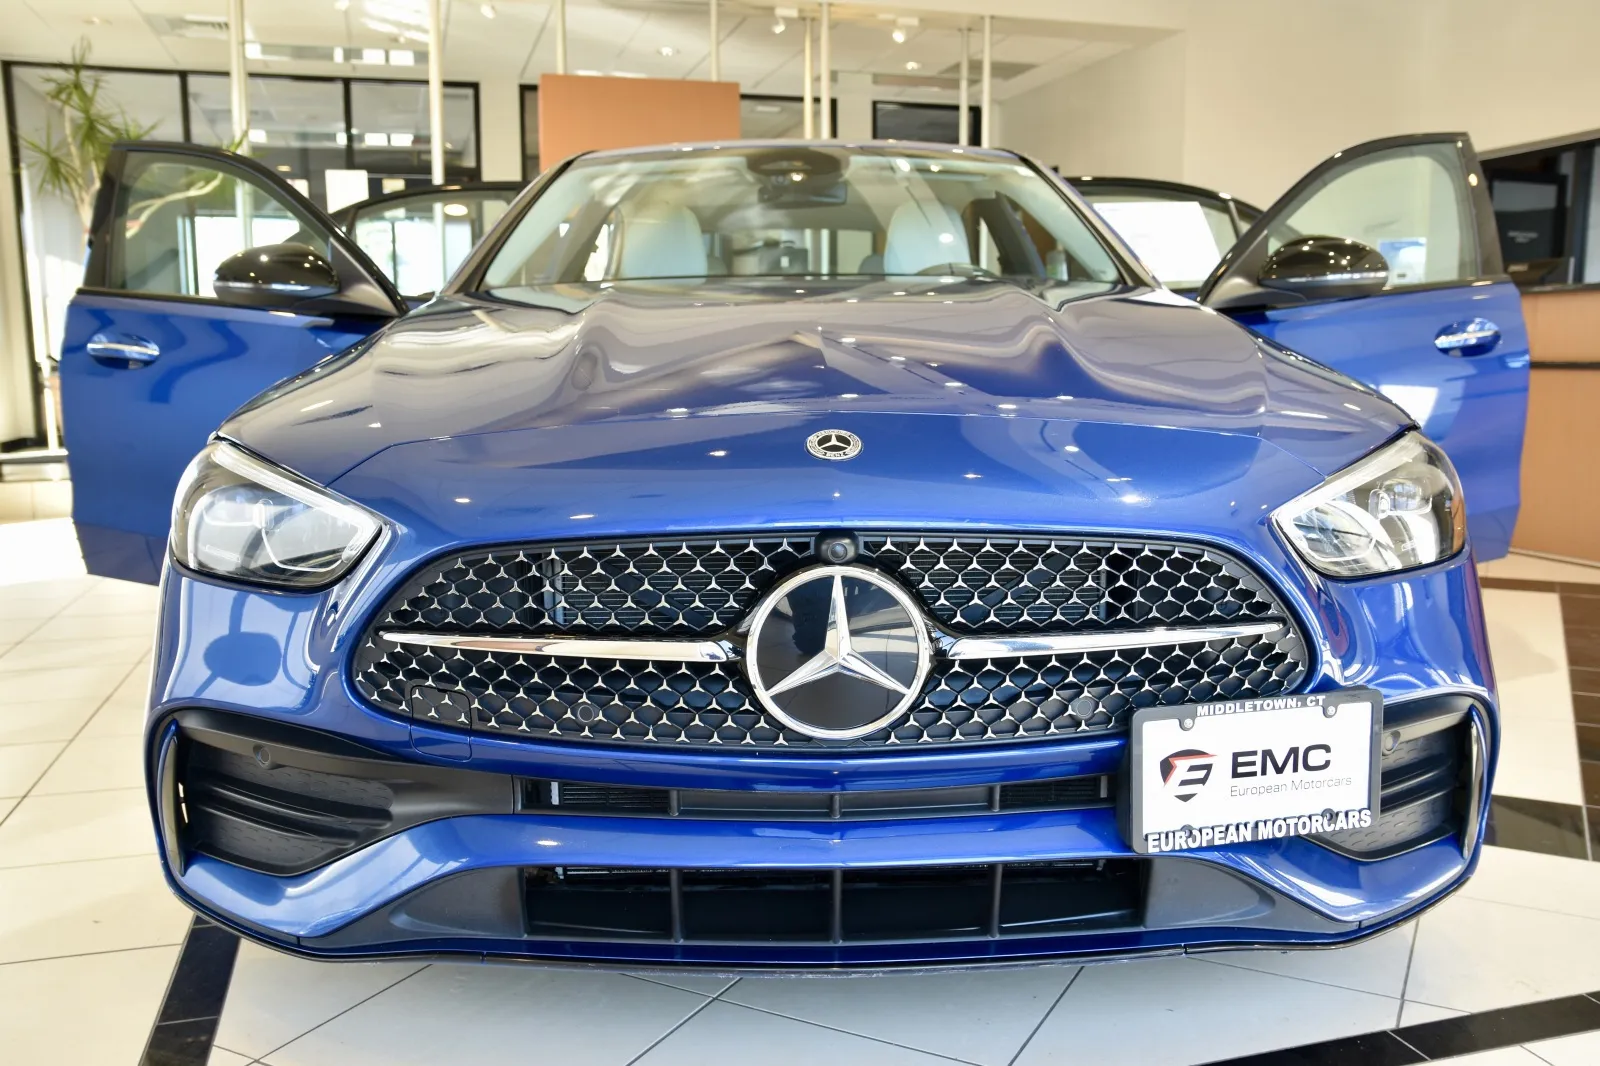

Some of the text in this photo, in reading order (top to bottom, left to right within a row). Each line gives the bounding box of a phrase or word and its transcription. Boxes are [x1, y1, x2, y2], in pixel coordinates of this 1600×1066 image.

[1196, 695, 1326, 717] MIDDLETOWN, CT
[1231, 743, 1332, 779] EMC
[1230, 777, 1352, 797] European Motorcars
[1146, 808, 1372, 854] EUROPEAN MOTORCARS
